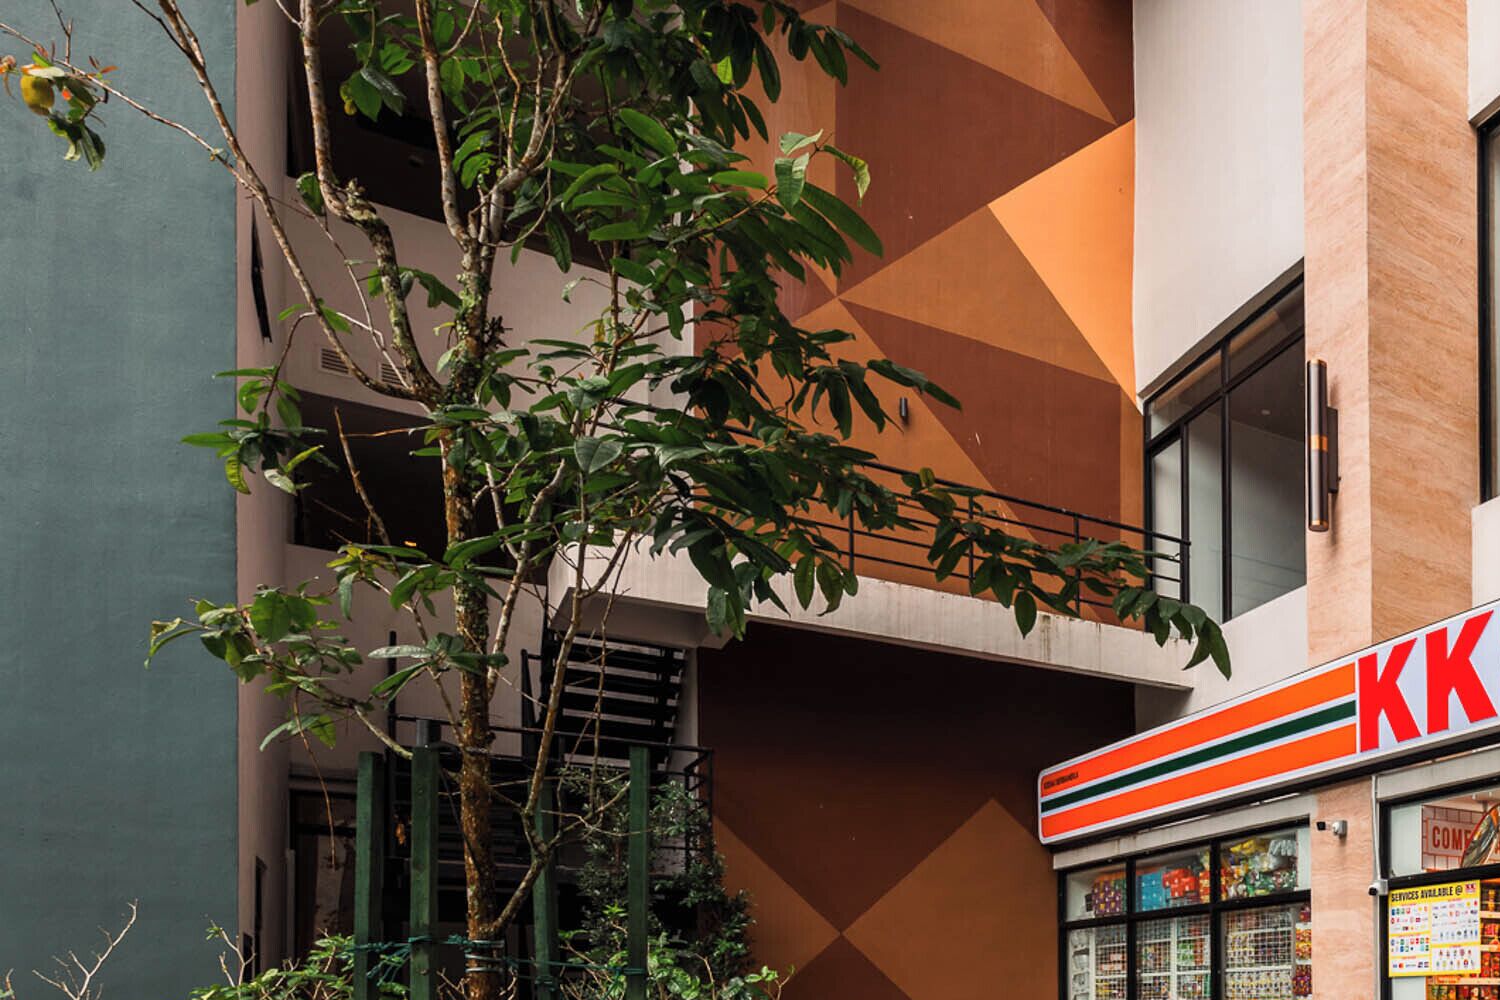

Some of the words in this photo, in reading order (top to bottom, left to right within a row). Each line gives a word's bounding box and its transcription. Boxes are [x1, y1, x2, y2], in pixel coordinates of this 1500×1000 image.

[1358, 609, 1499, 753] KK
[1391, 890, 1420, 902] SERVICES
[1420, 886, 1454, 899] AVAILABLE
[1455, 884, 1463, 896] @
